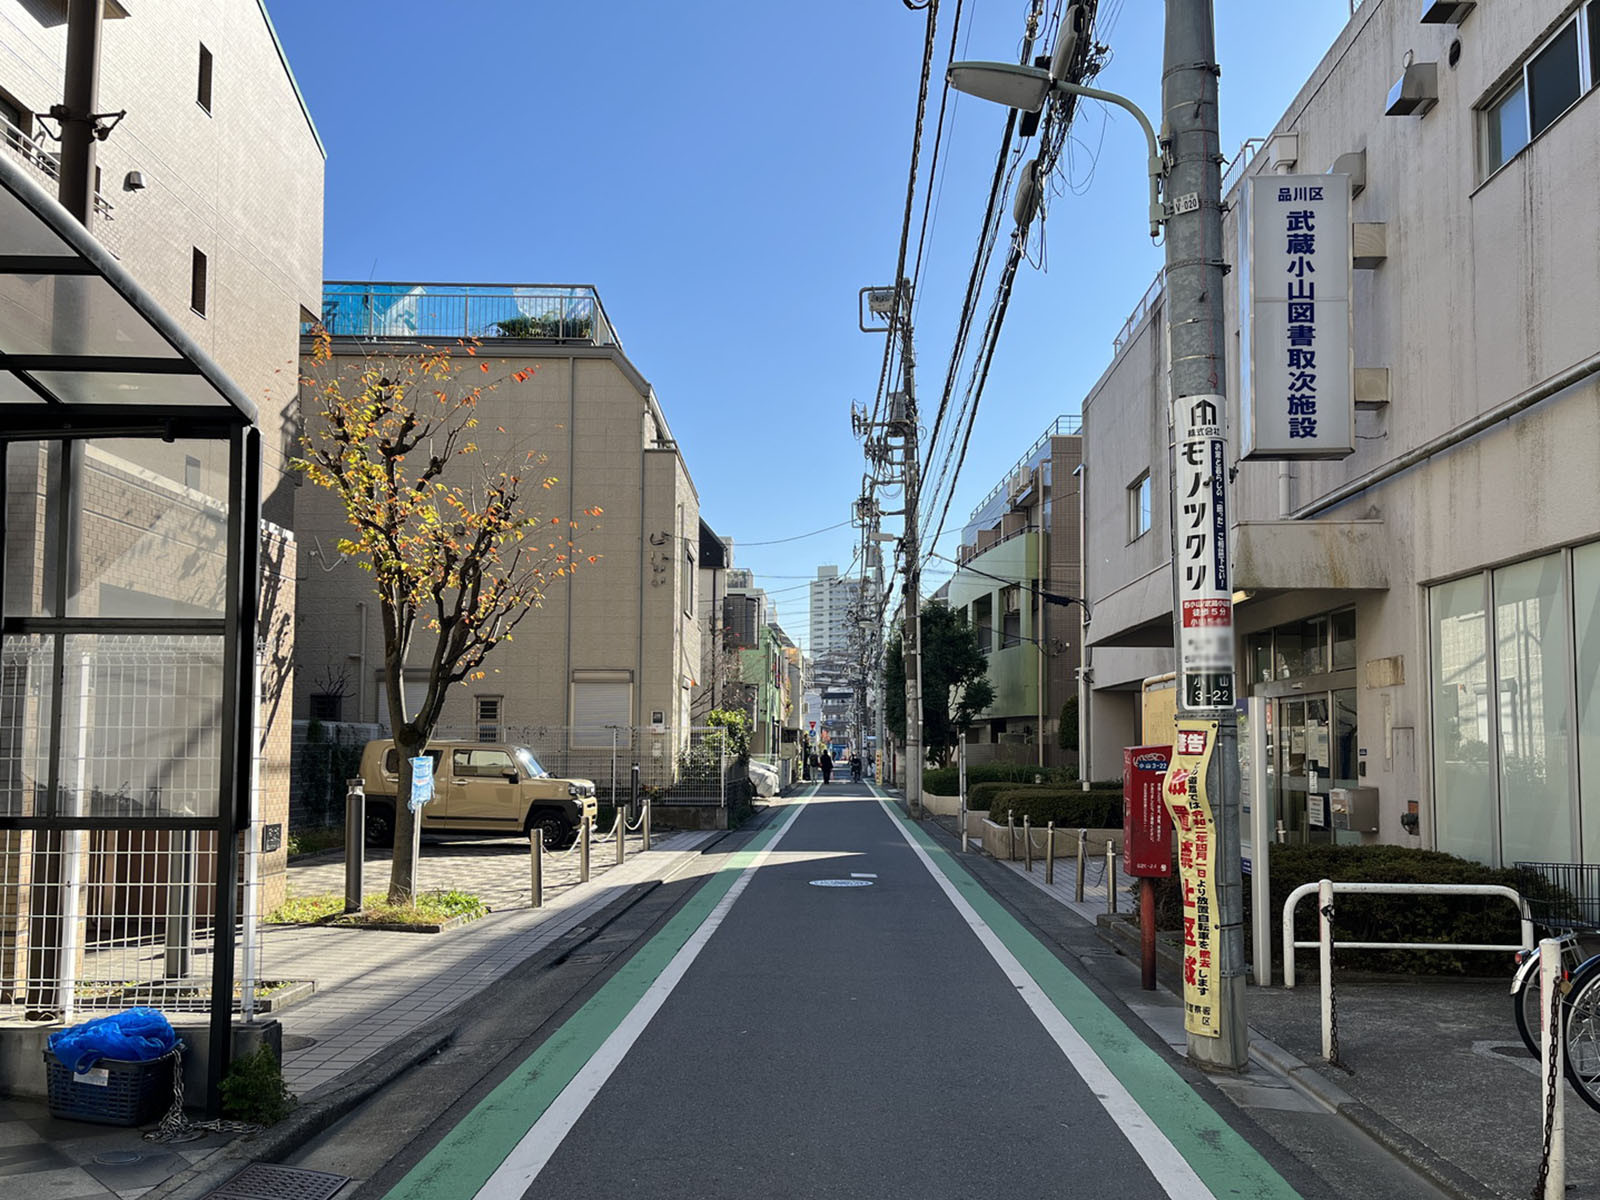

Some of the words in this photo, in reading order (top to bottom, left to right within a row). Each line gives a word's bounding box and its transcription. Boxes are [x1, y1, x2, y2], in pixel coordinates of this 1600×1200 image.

[1278, 187, 1324, 202] 品川区
[1286, 210, 1317, 439] 武蔵小山図書取次施設
[1181, 440, 1207, 591] モノツクリ
[1193, 675, 1229, 687] 小山
[1194, 690, 1229, 702] 3-22
